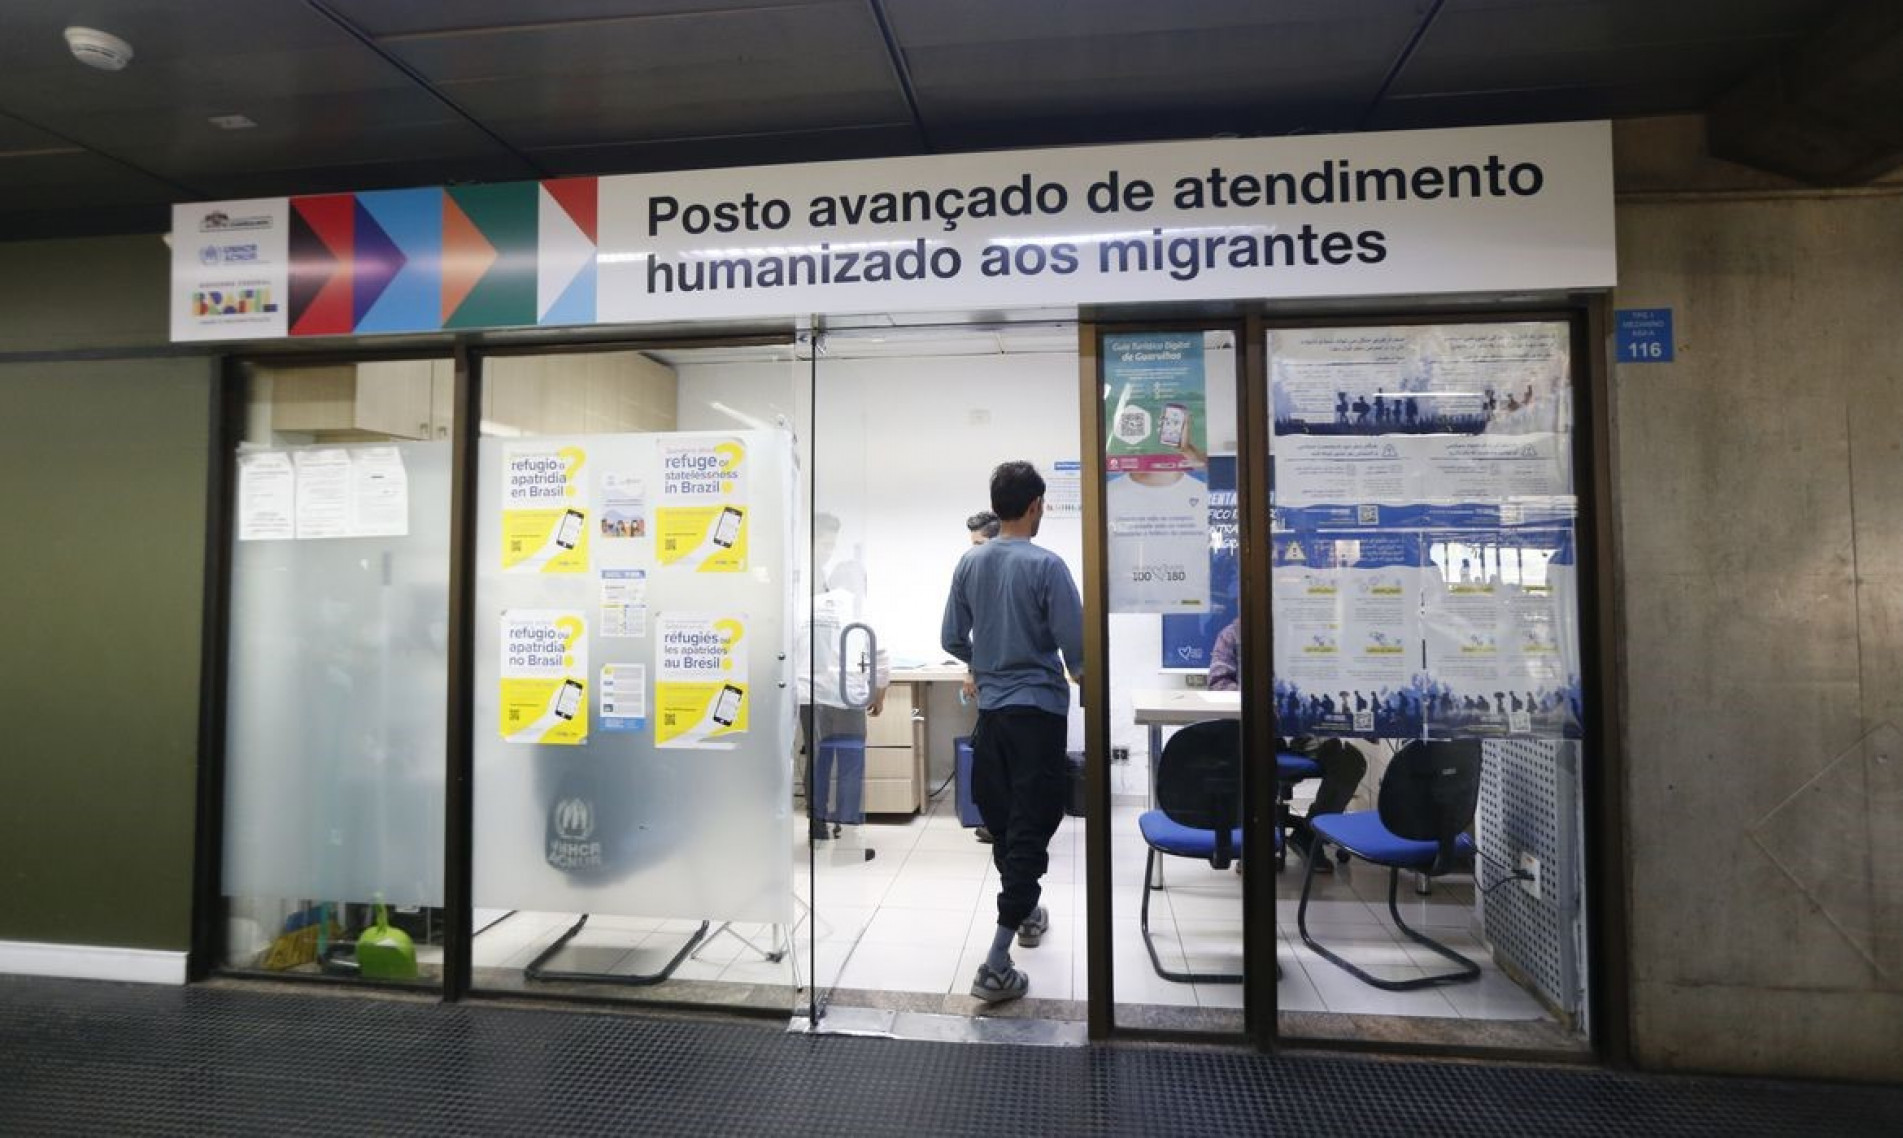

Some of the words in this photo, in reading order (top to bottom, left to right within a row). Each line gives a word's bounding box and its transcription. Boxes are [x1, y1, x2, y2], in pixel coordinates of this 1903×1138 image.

[648, 192, 792, 237] Posto
[808, 173, 1069, 232] avançado
[1086, 169, 1156, 214] de
[1173, 153, 1547, 211] atendimento
[647, 238, 962, 294] humanizado
[980, 241, 1079, 277] aos
[1100, 223, 1387, 281] migrantes
[1627, 342, 1663, 358] 116
[511, 459, 557, 474] refugio
[664, 453, 717, 471] refuge
[511, 471, 567, 487] apatridia
[664, 470, 738, 481] statelessness
[511, 487, 526, 498] en
[529, 485, 564, 498] Brasil
[664, 481, 677, 494] in
[681, 480, 720, 494] Brazil
[1132, 571, 1151, 581] 100
[1167, 571, 1186, 581] 180
[509, 641, 566, 654] apatridia
[509, 656, 524, 666] no
[528, 655, 563, 666] Brasil
[664, 659, 680, 669] au
[684, 656, 720, 669] Brésil
